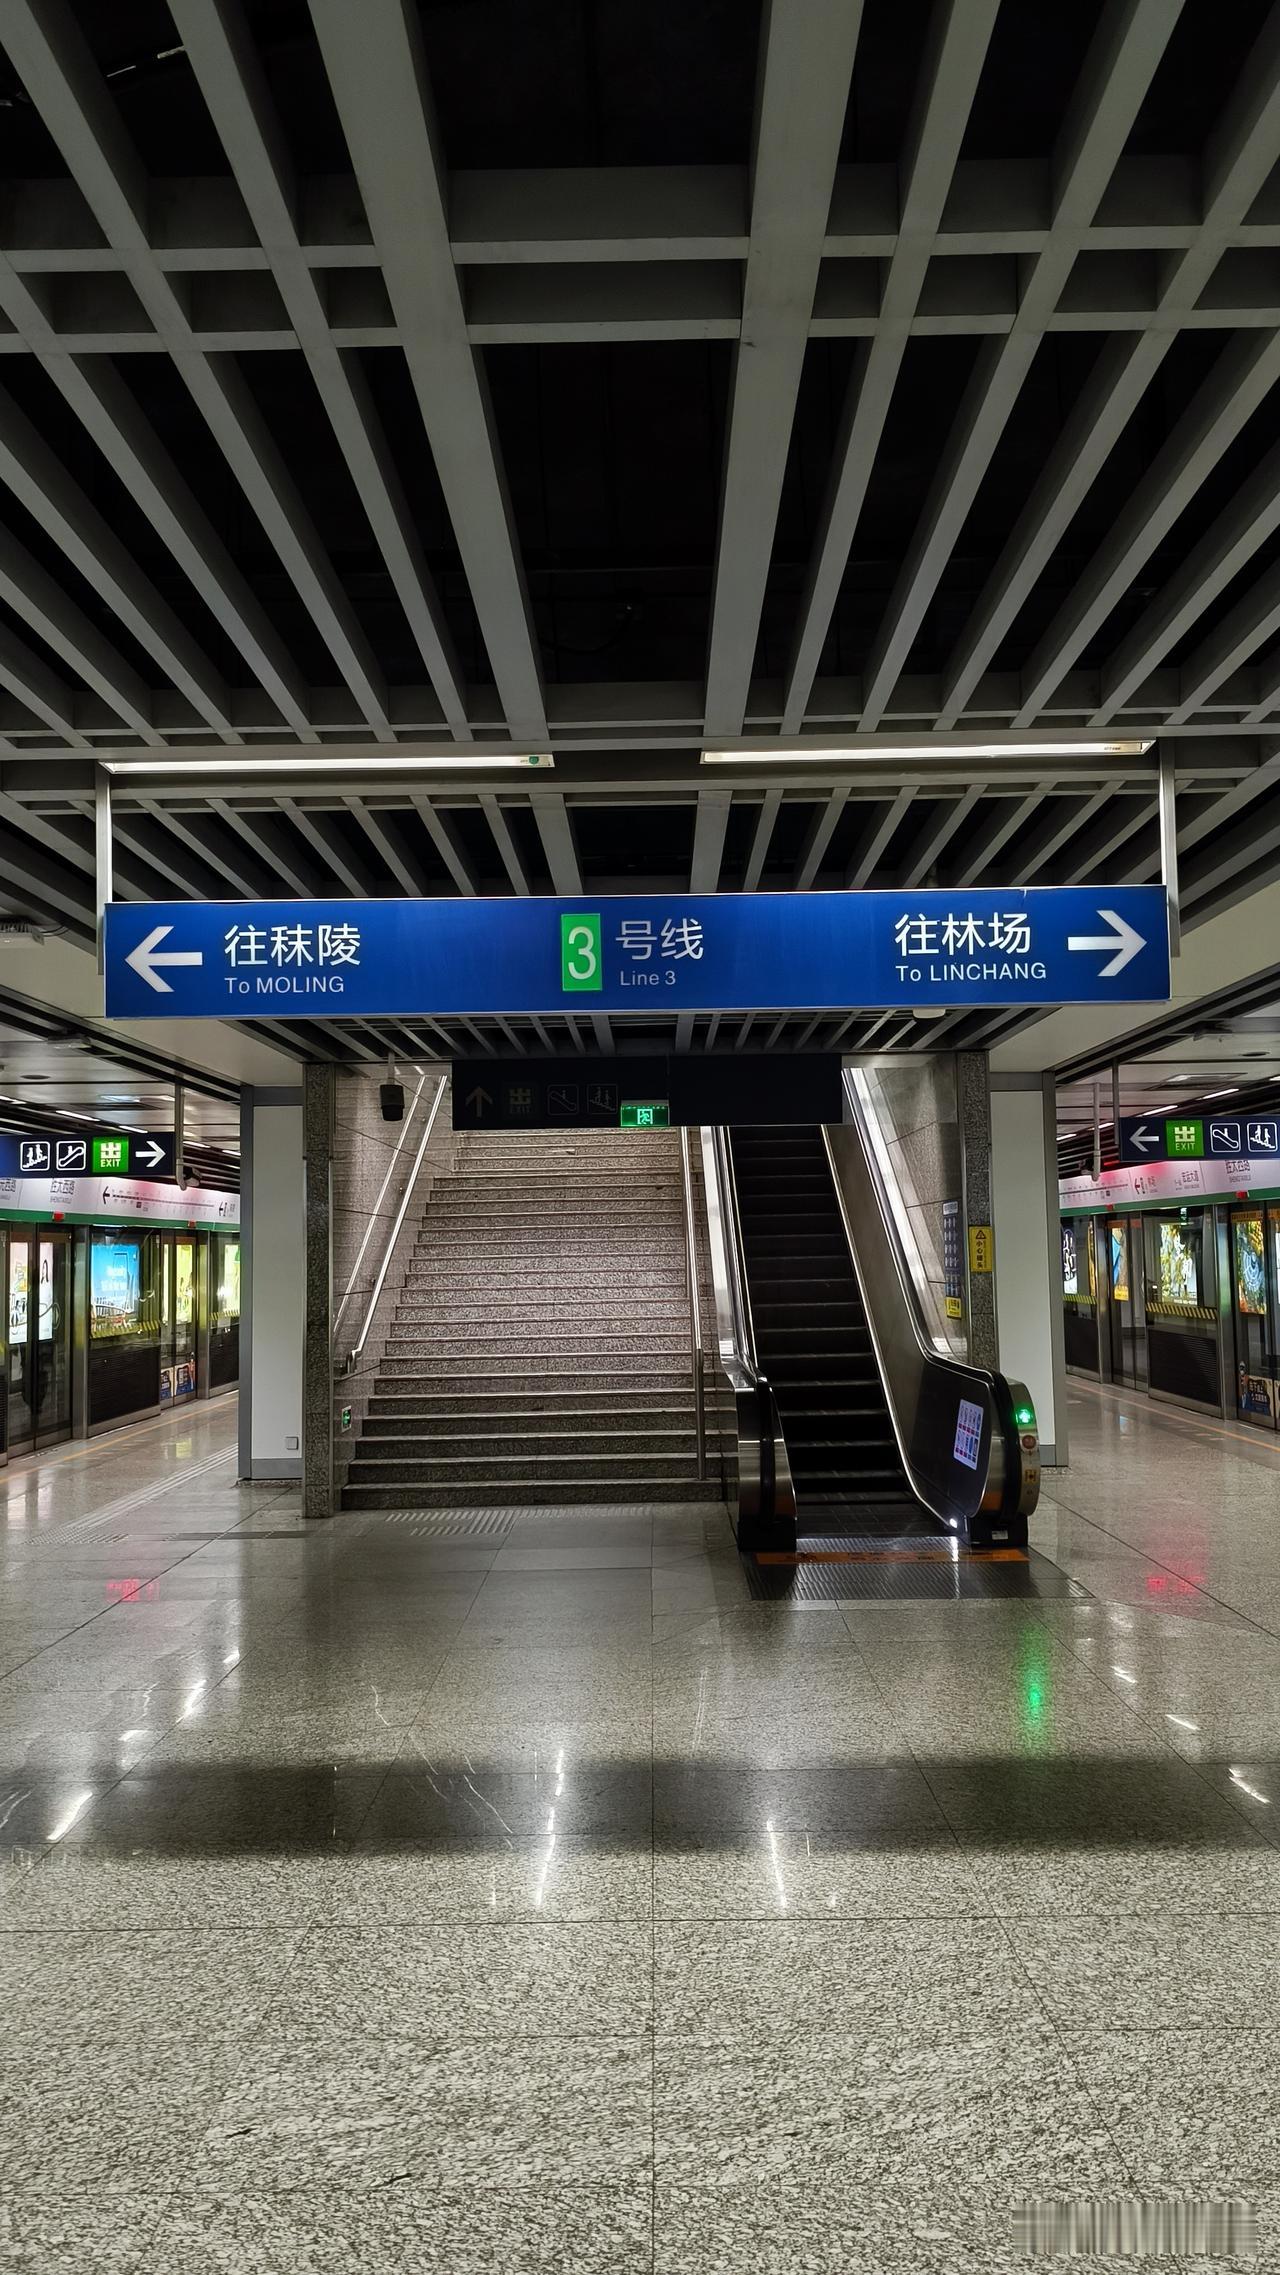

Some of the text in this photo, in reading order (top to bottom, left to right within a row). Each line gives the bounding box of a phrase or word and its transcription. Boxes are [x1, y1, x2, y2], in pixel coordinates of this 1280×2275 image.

[894, 911, 1031, 957] 往林场
[224, 922, 361, 967] 往秣陵
[568, 918, 704, 980] 3 号线
[620, 970, 676, 986] Line 3
[895, 962, 1047, 982] To LINCHANG
[224, 976, 344, 994] To MOLING
[1175, 1142, 1195, 1151] EXIT
[100, 1159, 120, 1168] EXIT
